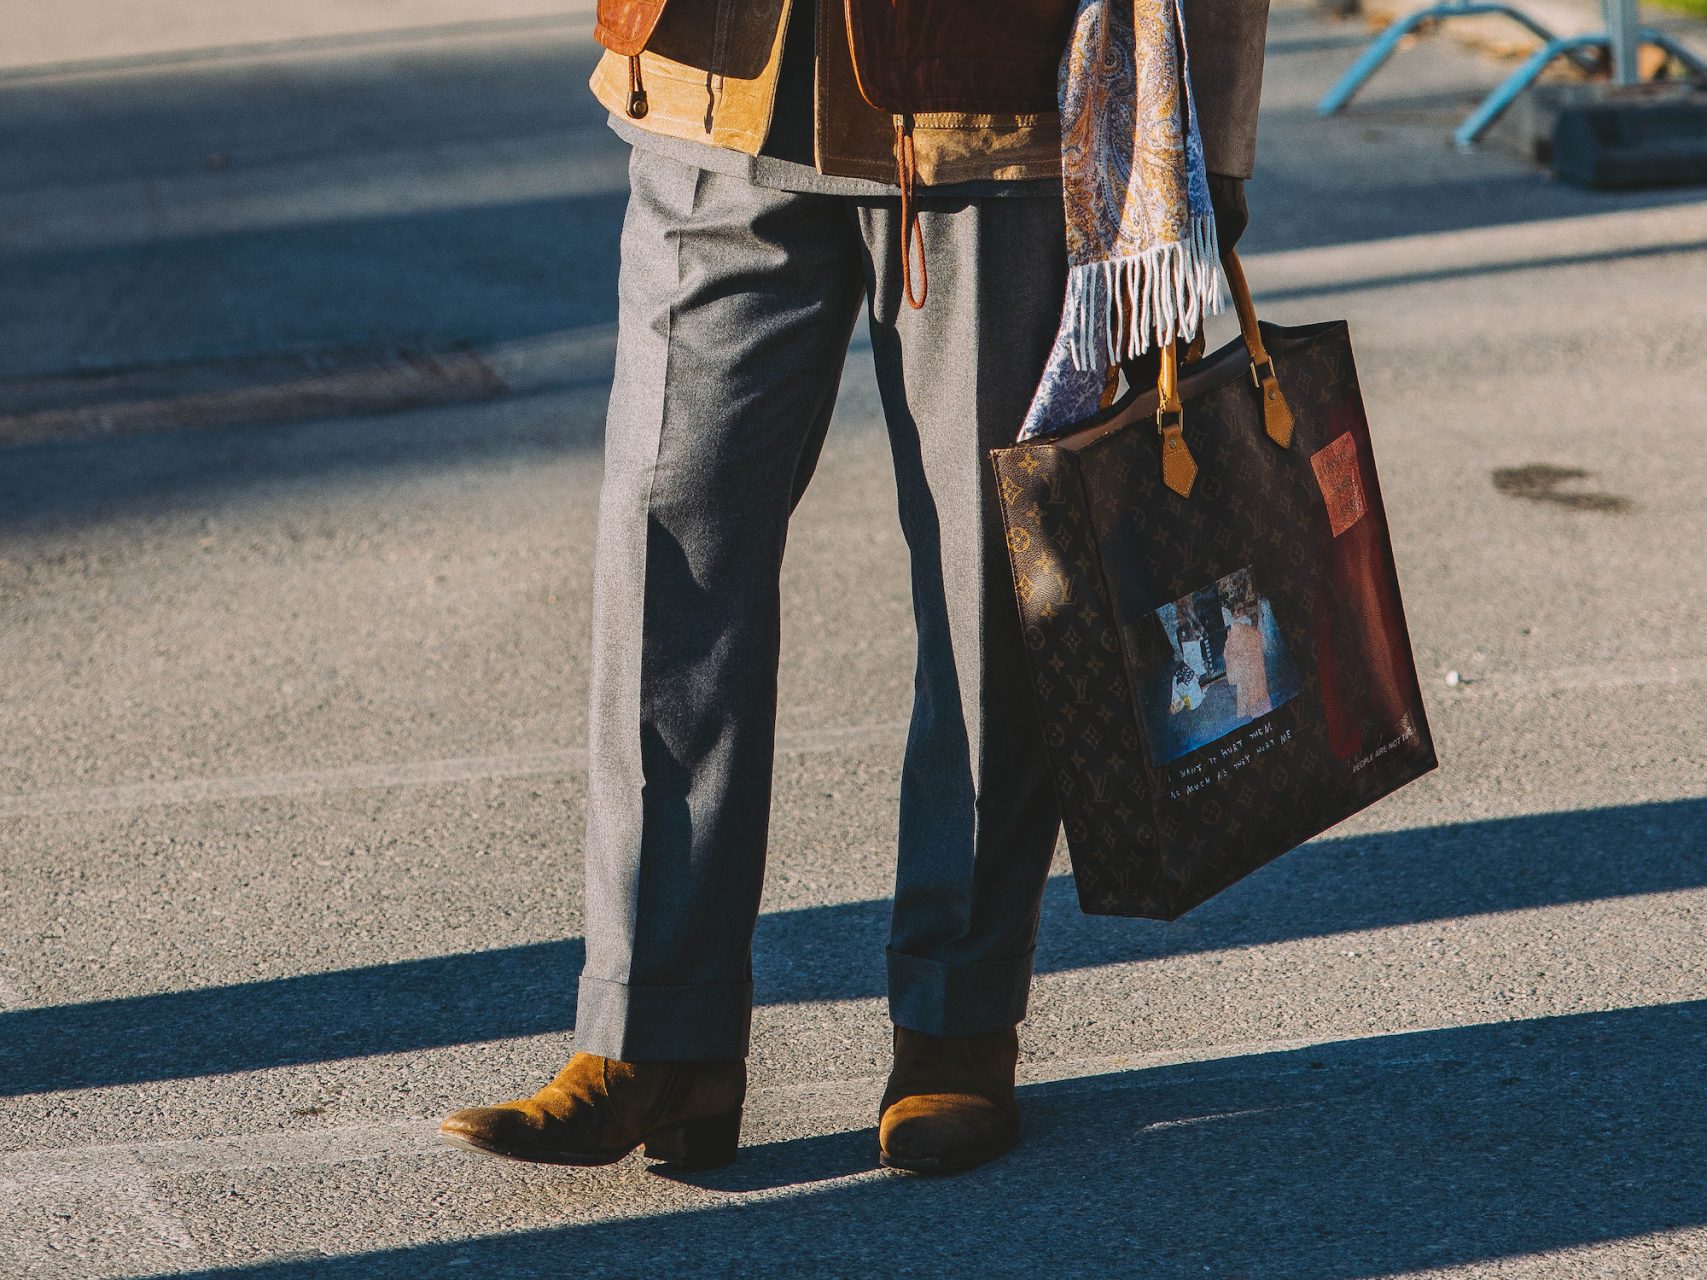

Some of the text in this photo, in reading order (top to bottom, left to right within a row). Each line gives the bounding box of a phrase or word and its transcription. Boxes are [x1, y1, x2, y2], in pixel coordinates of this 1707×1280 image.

[1220, 739, 1243, 758] HURT
[1249, 721, 1273, 739] THEM
[1353, 753, 1373, 773] PEOPLE
[1375, 745, 1388, 757] ARE
[1388, 736, 1401, 750] NOT
[1186, 777, 1211, 795] MUCH
[1217, 769, 1228, 781] AS
[1233, 754, 1251, 770] THEY
[1280, 729, 1292, 745] ME
